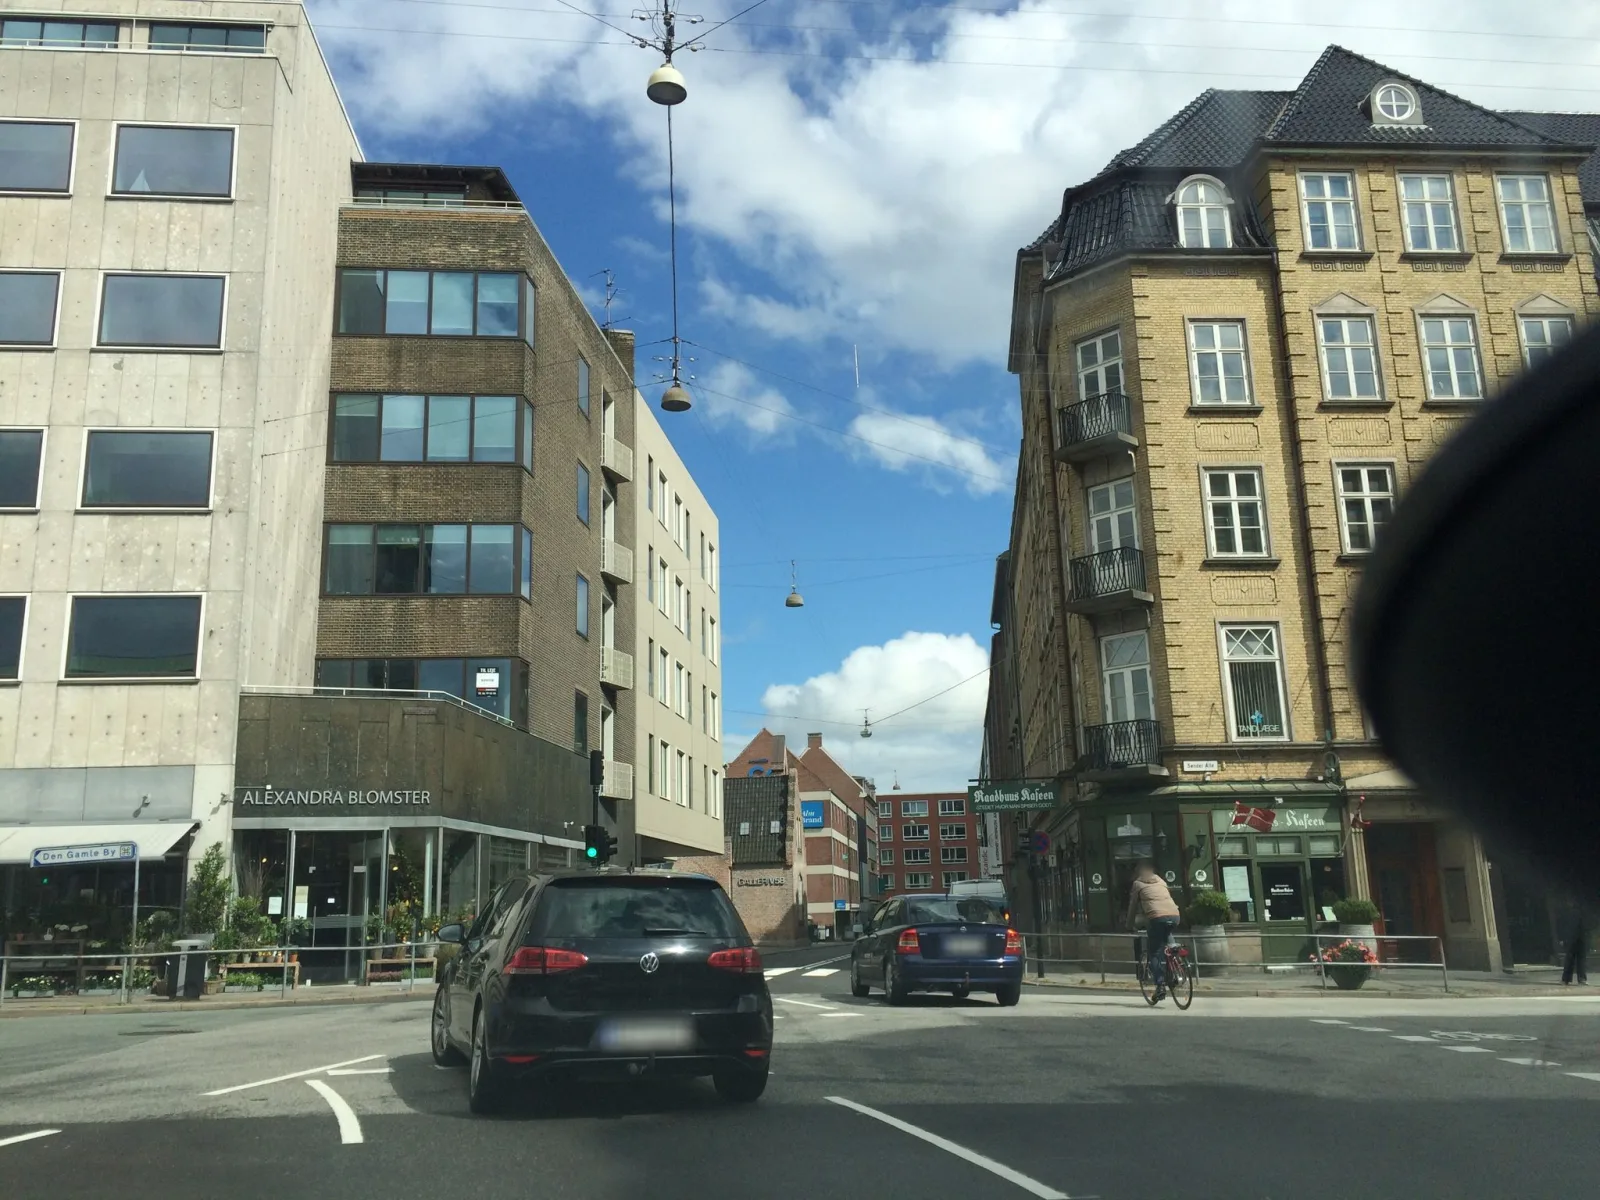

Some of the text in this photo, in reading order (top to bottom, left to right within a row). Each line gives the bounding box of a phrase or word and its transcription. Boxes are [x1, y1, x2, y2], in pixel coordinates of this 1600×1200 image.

[242, 790, 430, 805] ALEXANDRA BLOMSTER
[974, 790, 1019, 803] Raadhuus
[43, 848, 116, 861] Den Gamle By
